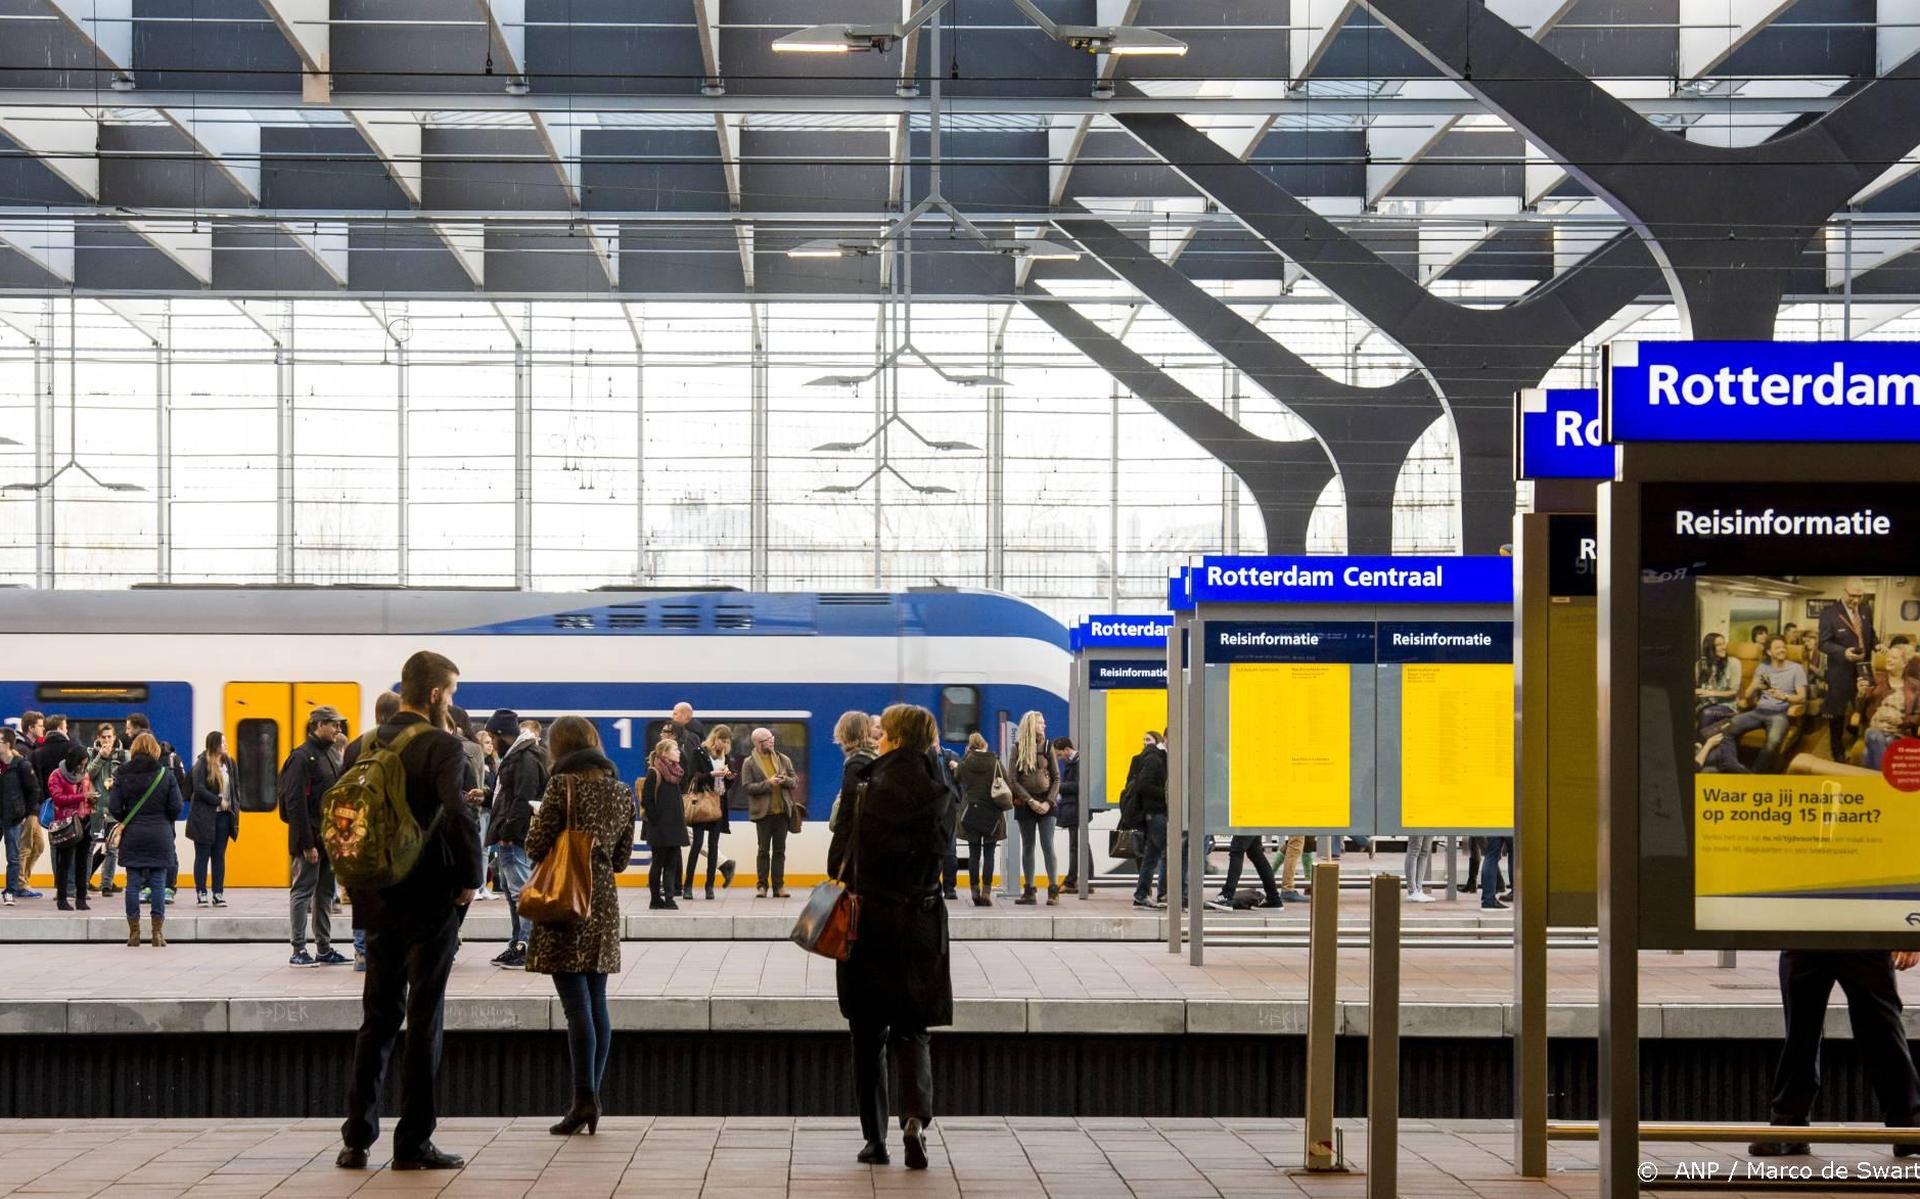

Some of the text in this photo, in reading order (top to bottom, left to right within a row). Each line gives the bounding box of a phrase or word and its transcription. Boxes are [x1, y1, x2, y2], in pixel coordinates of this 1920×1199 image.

[1648, 361, 1920, 406] Rotterdam
[1676, 508, 1891, 535] Reisinformatie
[1207, 564, 1443, 588] Rotterdam Centraal
[1220, 632, 1319, 646] Reisinformatie
[1392, 632, 1492, 646] Reisinformatie
[1100, 667, 1167, 678] Reisinformatie
[612, 718, 632, 748] 1
[1703, 788, 1747, 804] Waar
[1752, 791, 1773, 808] ga
[1778, 788, 1793, 808] jij
[1703, 807, 1881, 825] op zondag 15 maart?
